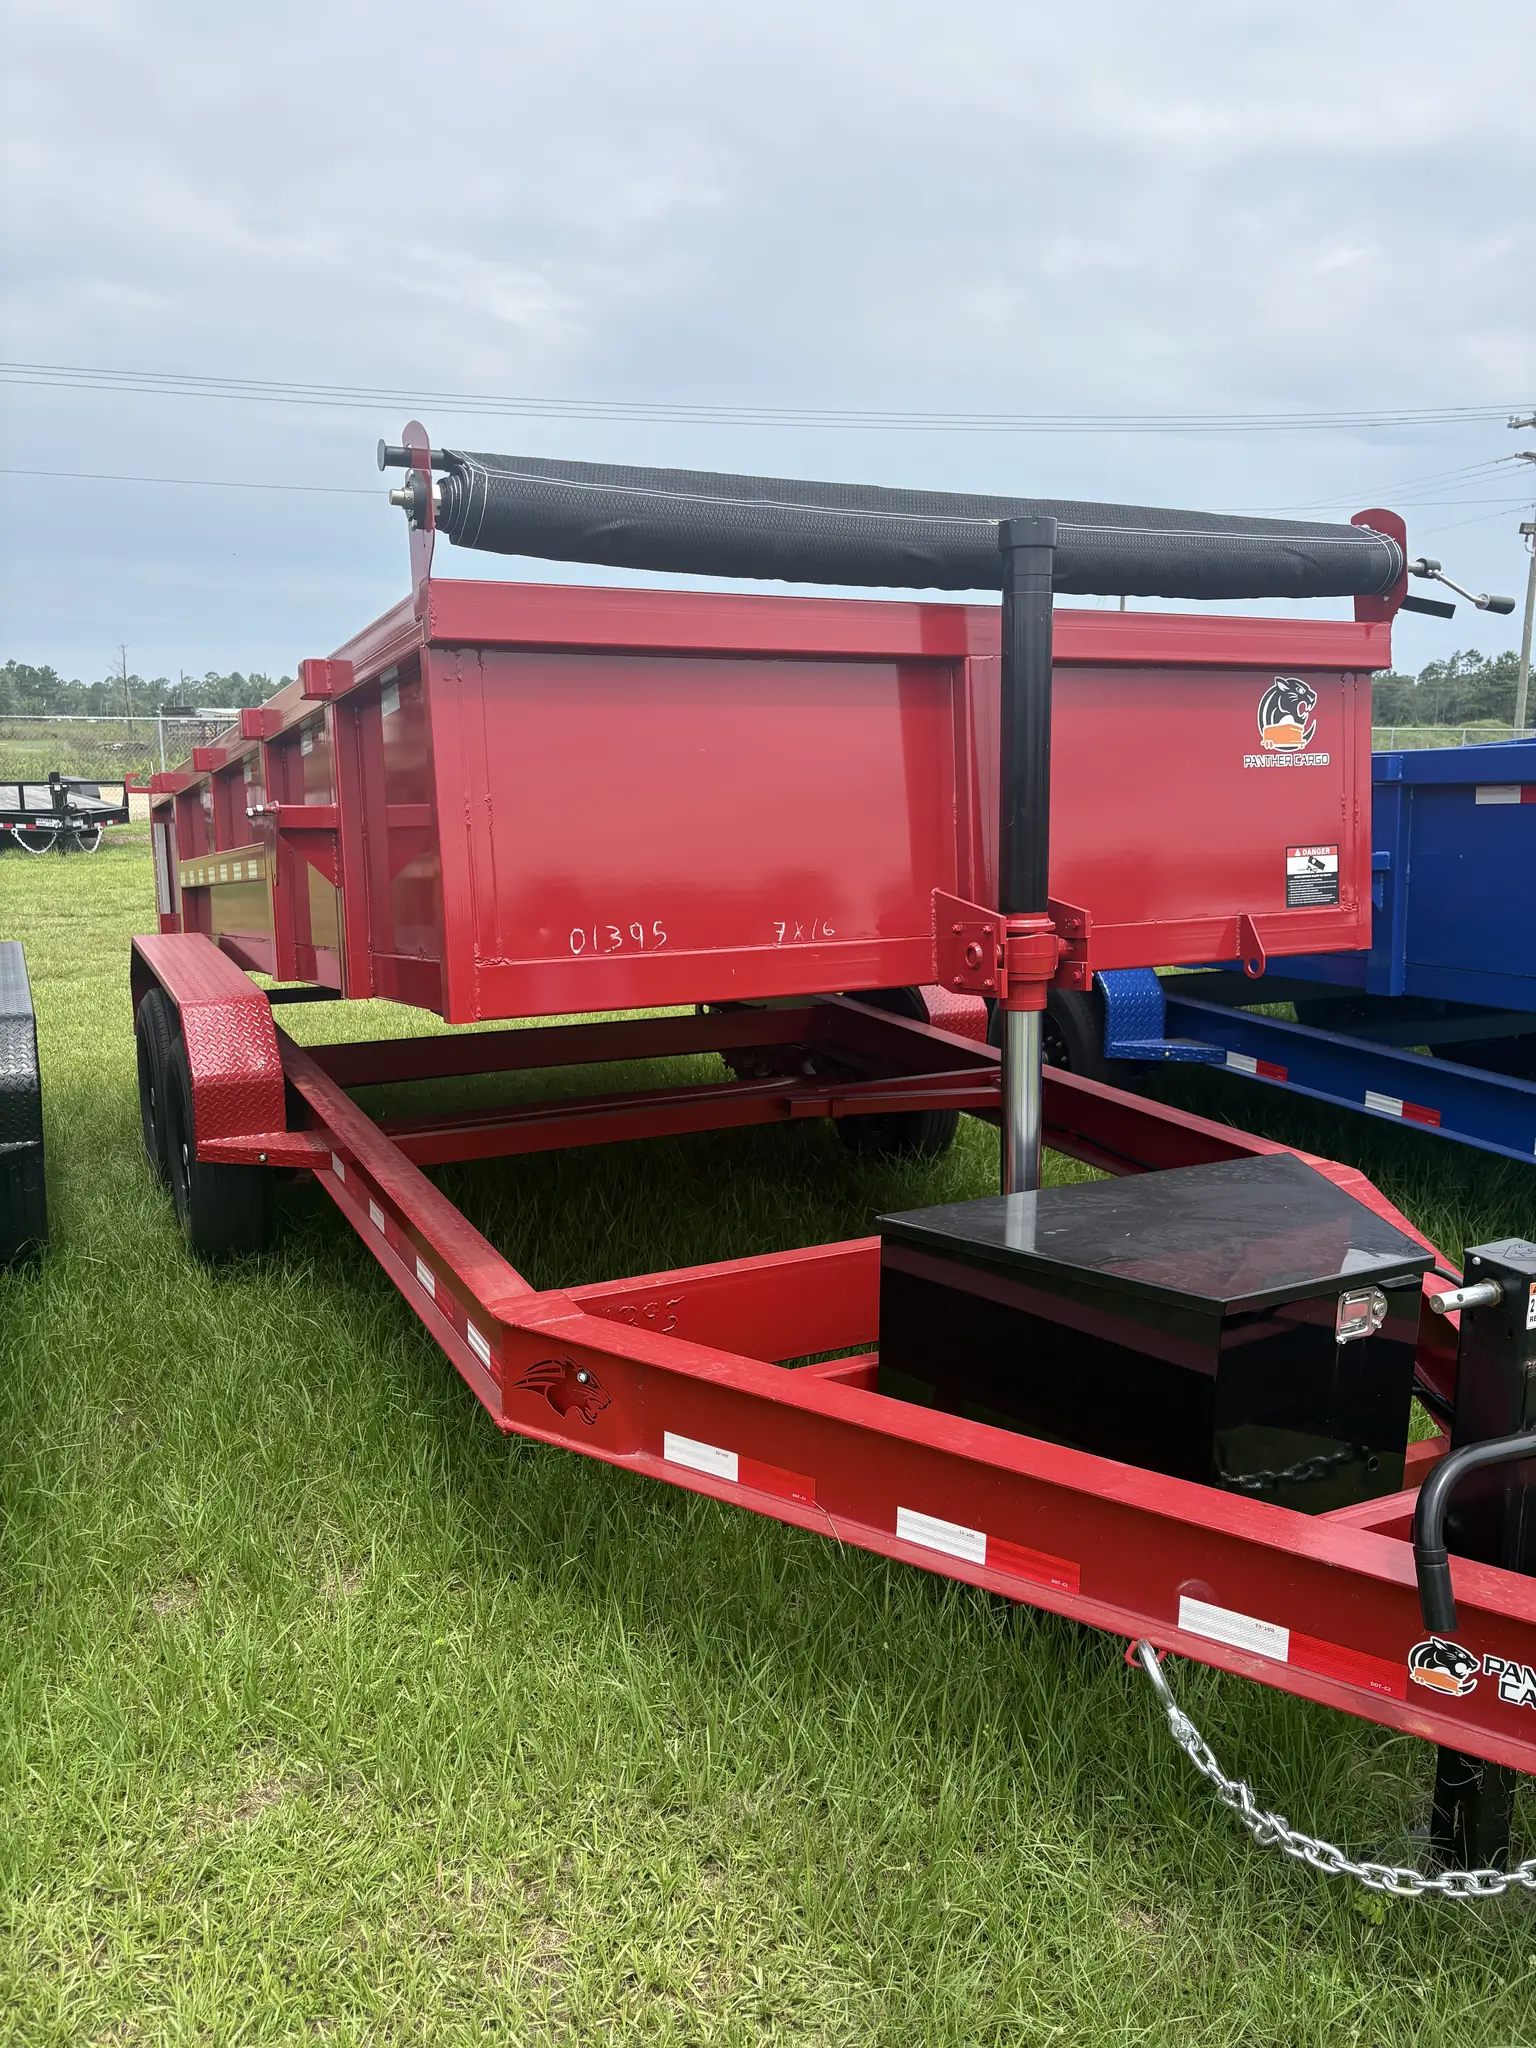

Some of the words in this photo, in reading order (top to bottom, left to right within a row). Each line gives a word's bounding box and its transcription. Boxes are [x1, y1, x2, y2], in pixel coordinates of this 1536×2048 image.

[1243, 754, 1292, 768] PANTHER
[1294, 753, 1329, 766] CARGO
[1302, 847, 1330, 856] DANGER
[569, 920, 668, 955] 01395
